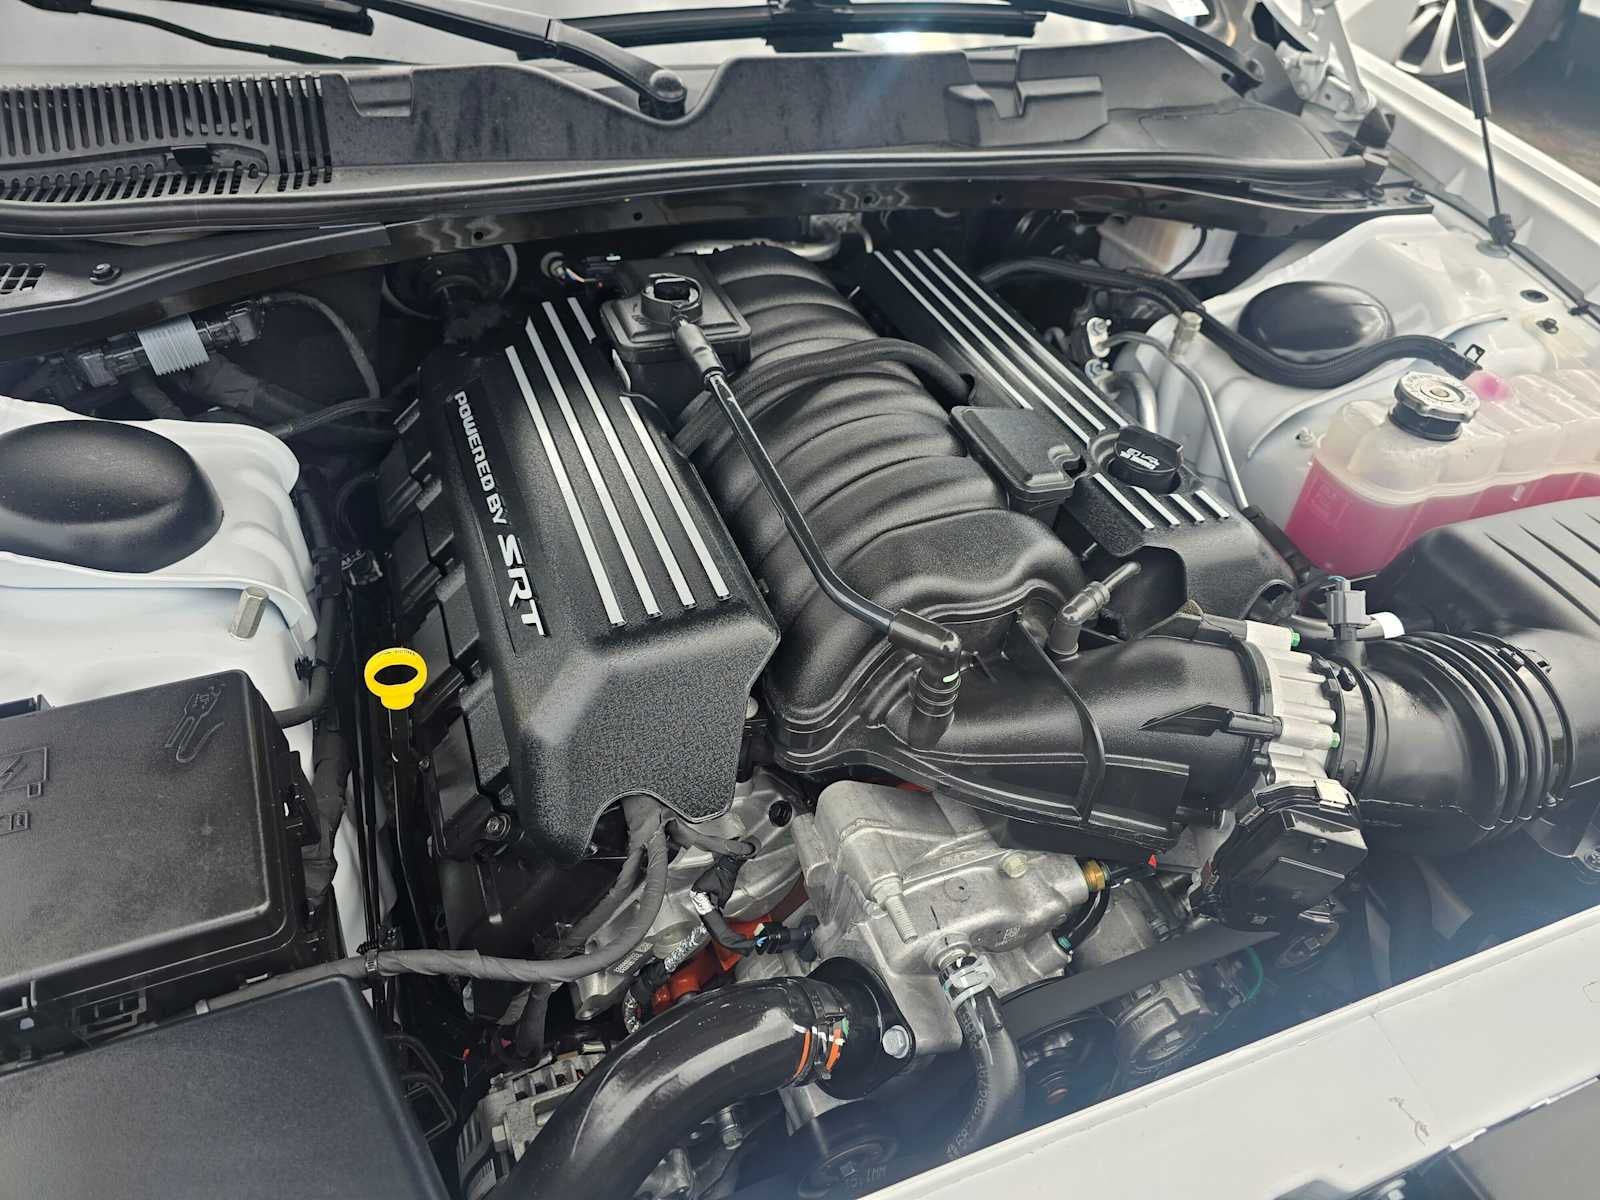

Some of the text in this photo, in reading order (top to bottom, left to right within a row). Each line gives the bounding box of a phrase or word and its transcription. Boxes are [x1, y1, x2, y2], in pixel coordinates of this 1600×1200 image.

[454, 390, 545, 636] POWERED BY SRT
